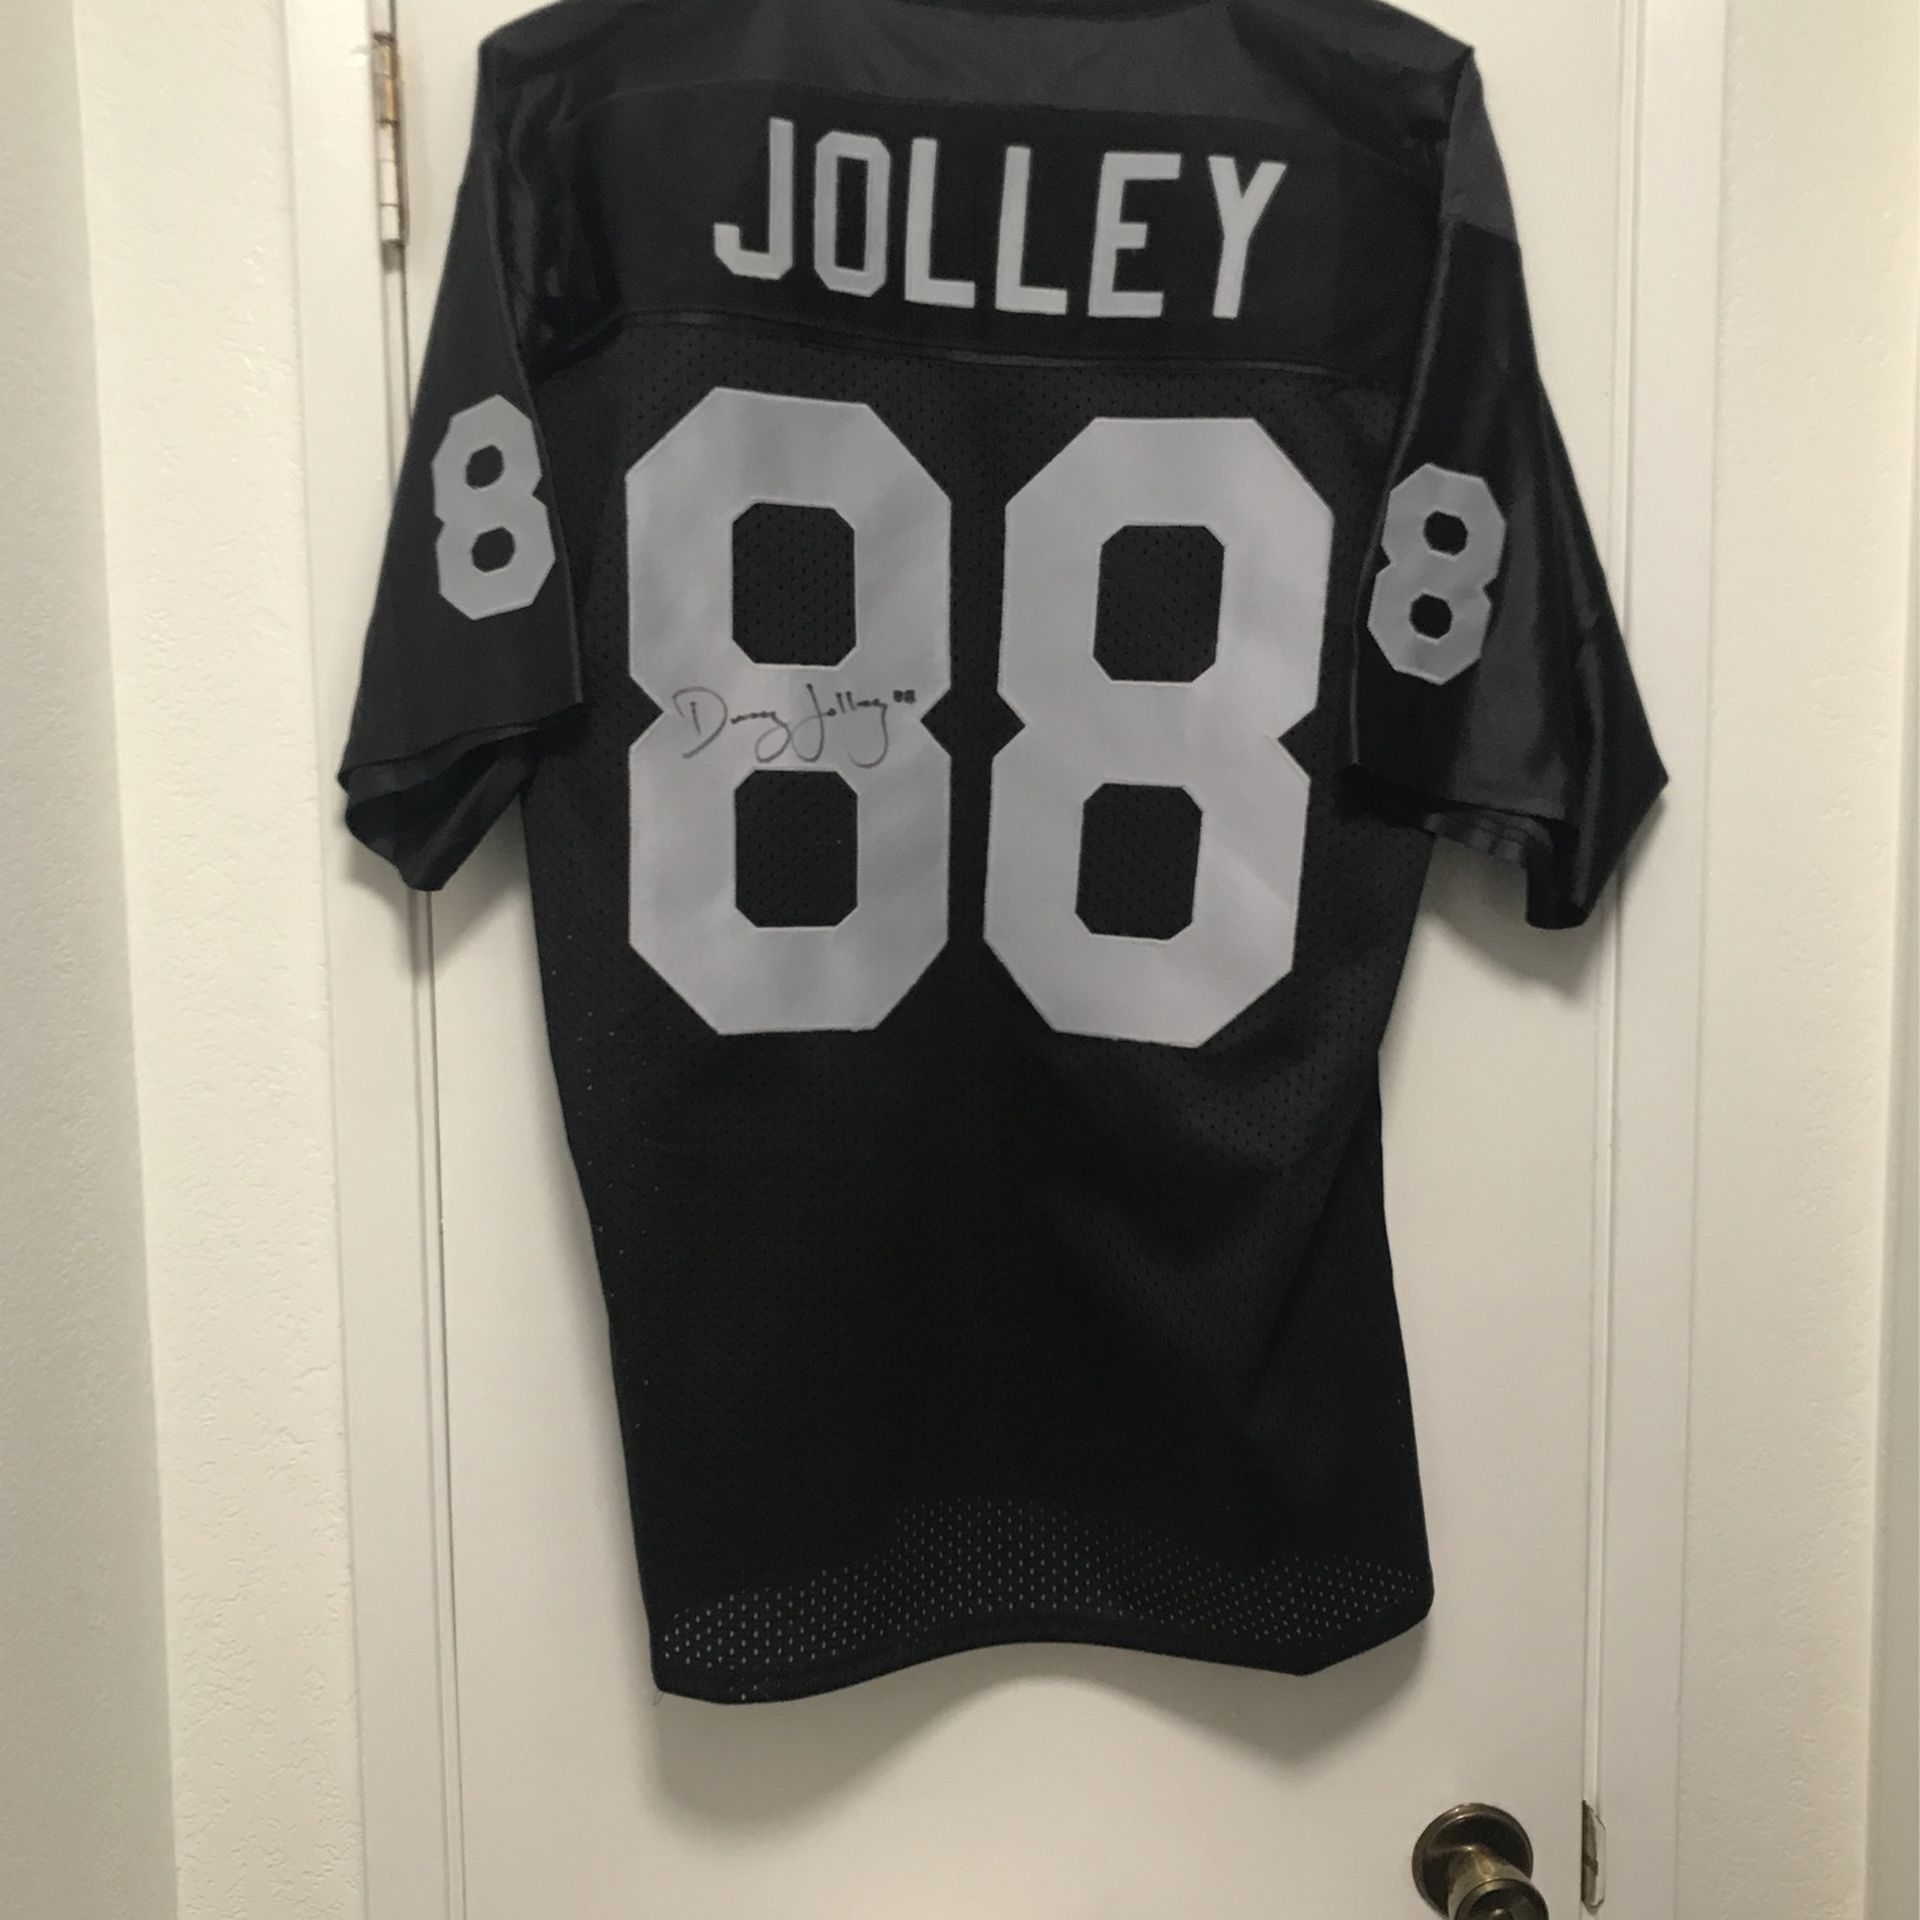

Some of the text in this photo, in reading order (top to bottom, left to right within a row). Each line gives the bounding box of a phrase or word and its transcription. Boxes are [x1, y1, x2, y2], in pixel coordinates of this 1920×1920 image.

[713, 117, 1288, 320] JOLLEY
[431, 394, 557, 621] 8
[1366, 463, 1506, 685] 8
[625, 386, 1334, 1049] 88
